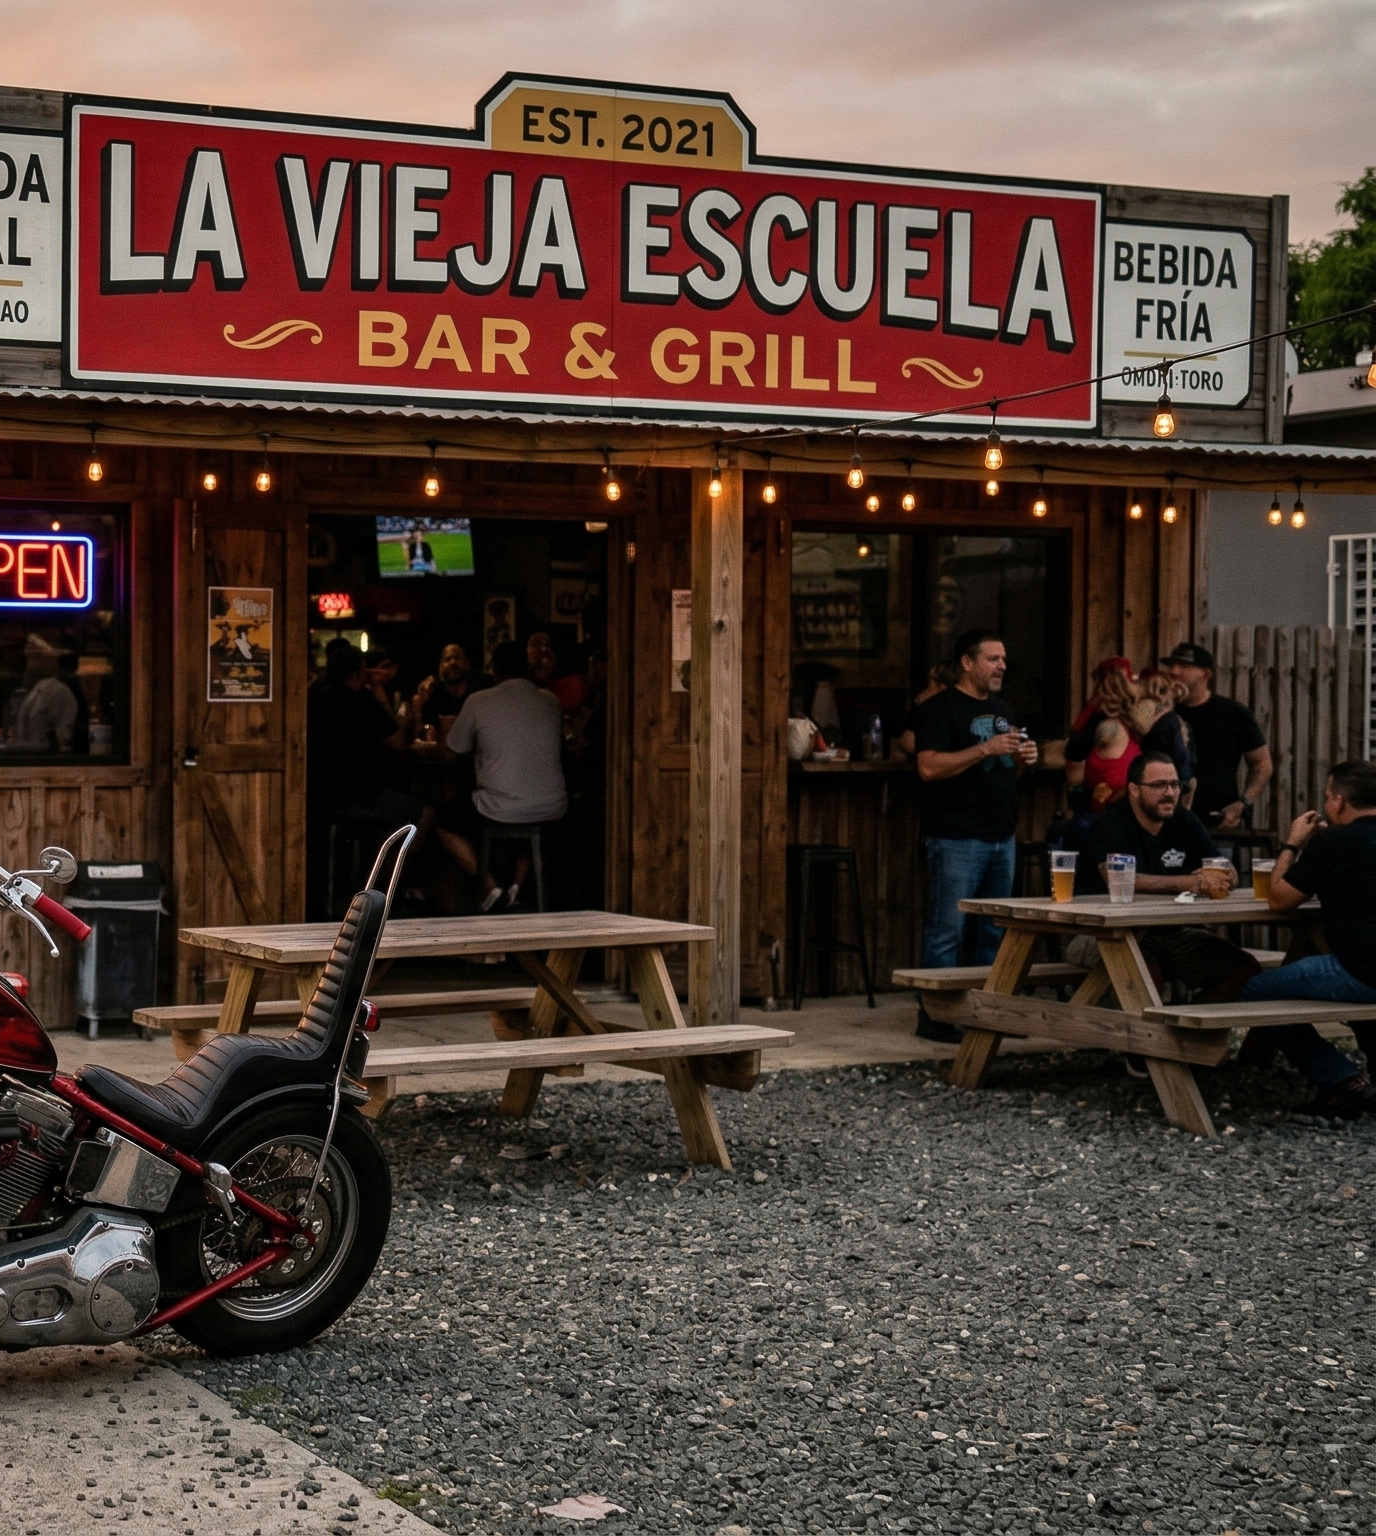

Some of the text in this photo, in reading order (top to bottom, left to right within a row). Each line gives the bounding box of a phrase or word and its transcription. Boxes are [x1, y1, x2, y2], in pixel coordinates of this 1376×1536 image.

[523, 104, 714, 157] EST. 2021
[101, 141, 1076, 354] LA VIEJA ESCUELA
[1113, 241, 1238, 289] BEBIDA
[1135, 290, 1213, 343] FRÍA
[358, 310, 877, 394] BAR & GRILL
